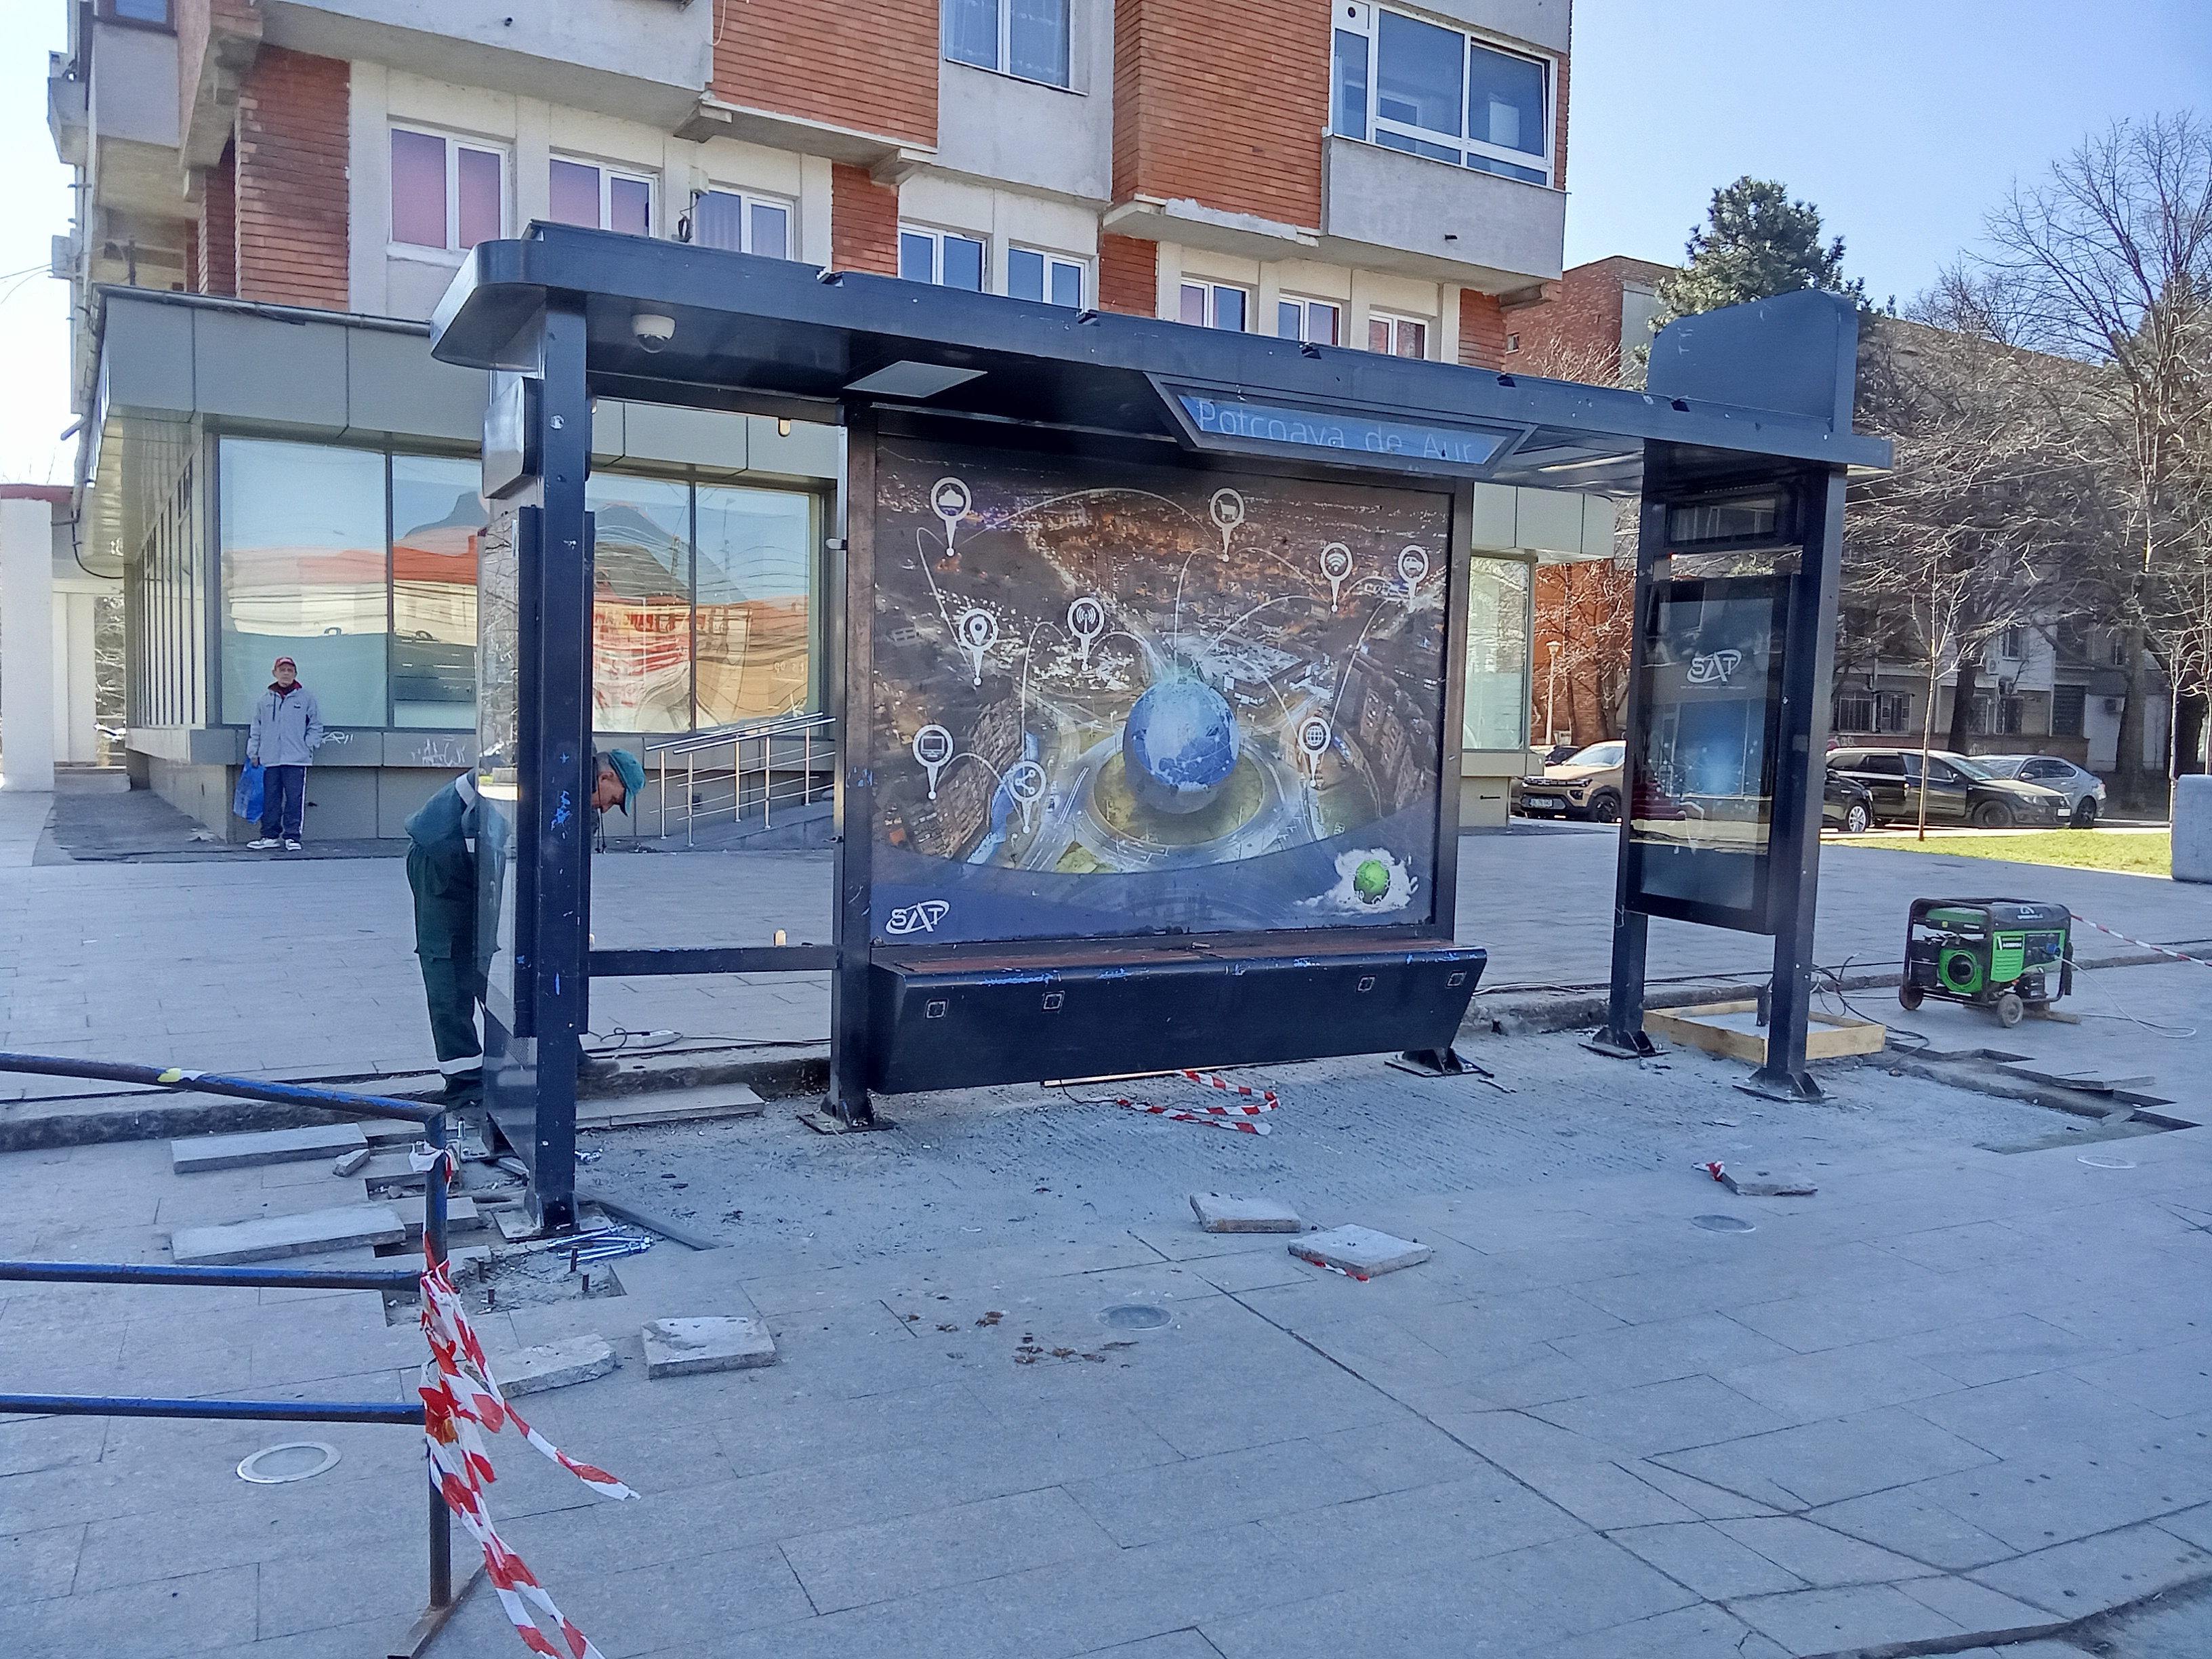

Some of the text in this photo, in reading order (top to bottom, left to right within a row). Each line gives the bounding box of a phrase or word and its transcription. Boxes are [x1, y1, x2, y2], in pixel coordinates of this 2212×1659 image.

[1199, 400, 1471, 462] Potcoava de Aur
[1690, 651, 1738, 682] SAT
[890, 901, 945, 933] SAT
